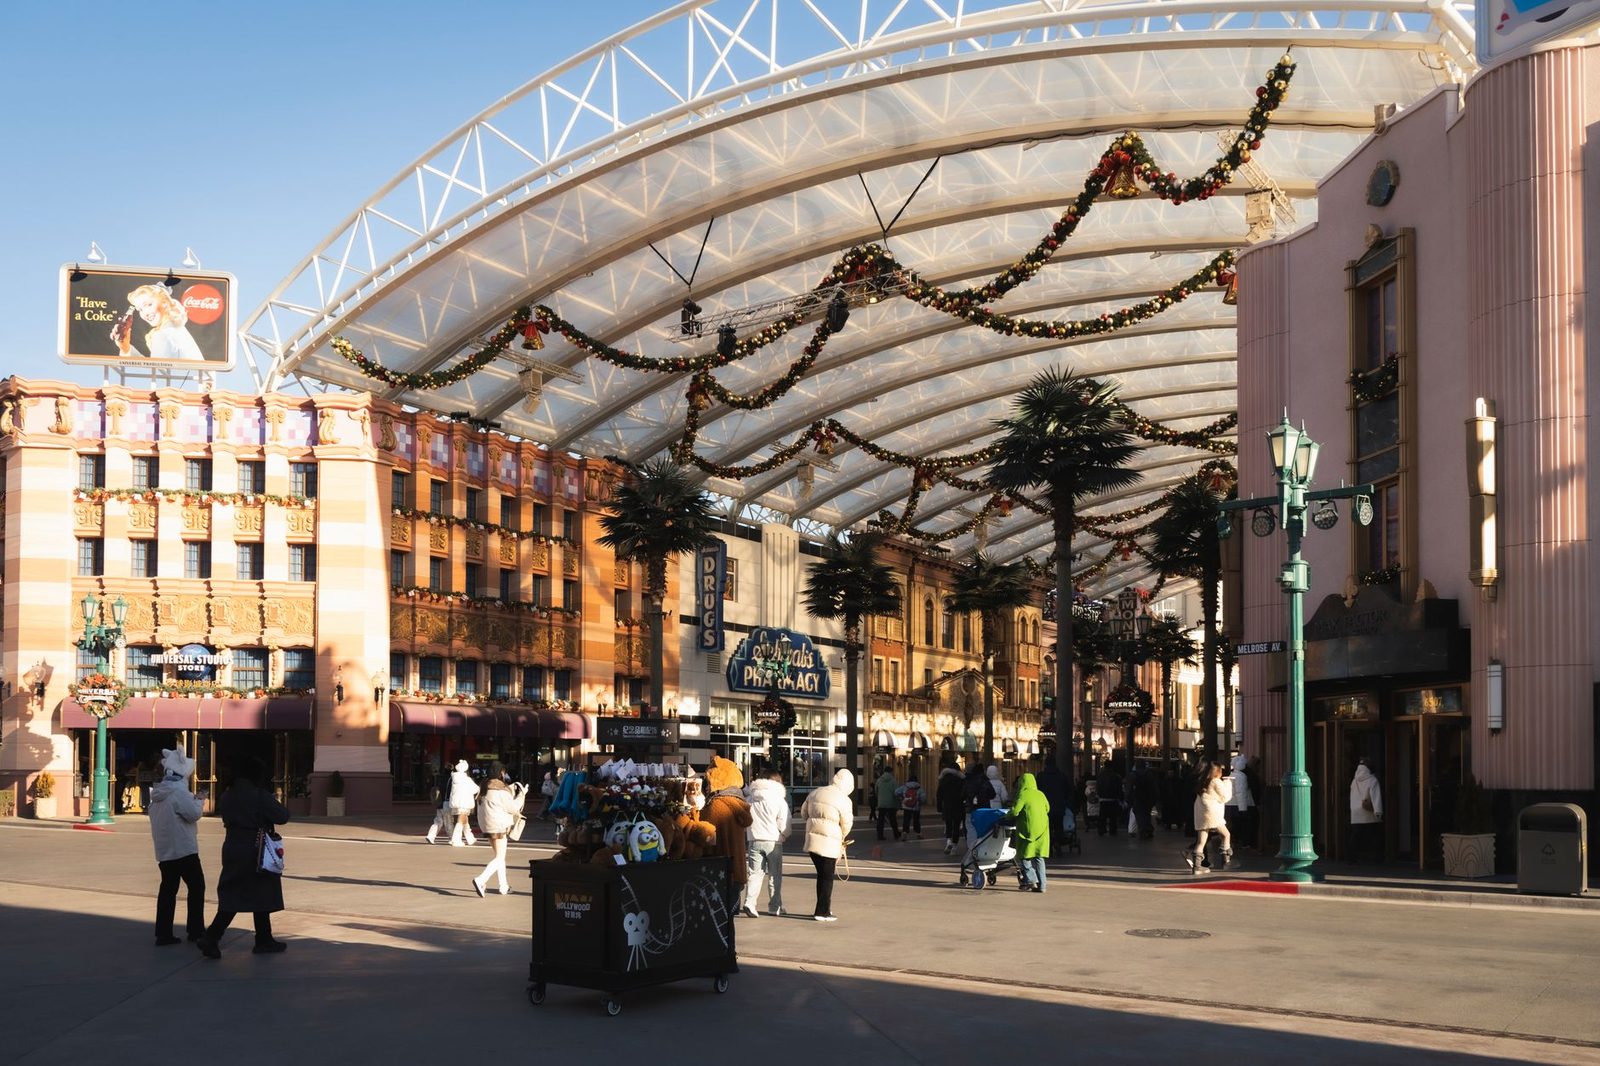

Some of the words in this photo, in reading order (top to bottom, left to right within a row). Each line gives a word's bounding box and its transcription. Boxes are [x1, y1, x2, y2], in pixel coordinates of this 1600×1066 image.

[74, 313, 82, 321] a
[703, 556, 716, 647] DRUGS
[1237, 643, 1268, 654] MELROSE
[151, 654, 195, 664] UNIVERSAL
[196, 654, 234, 665] STUDIOS
